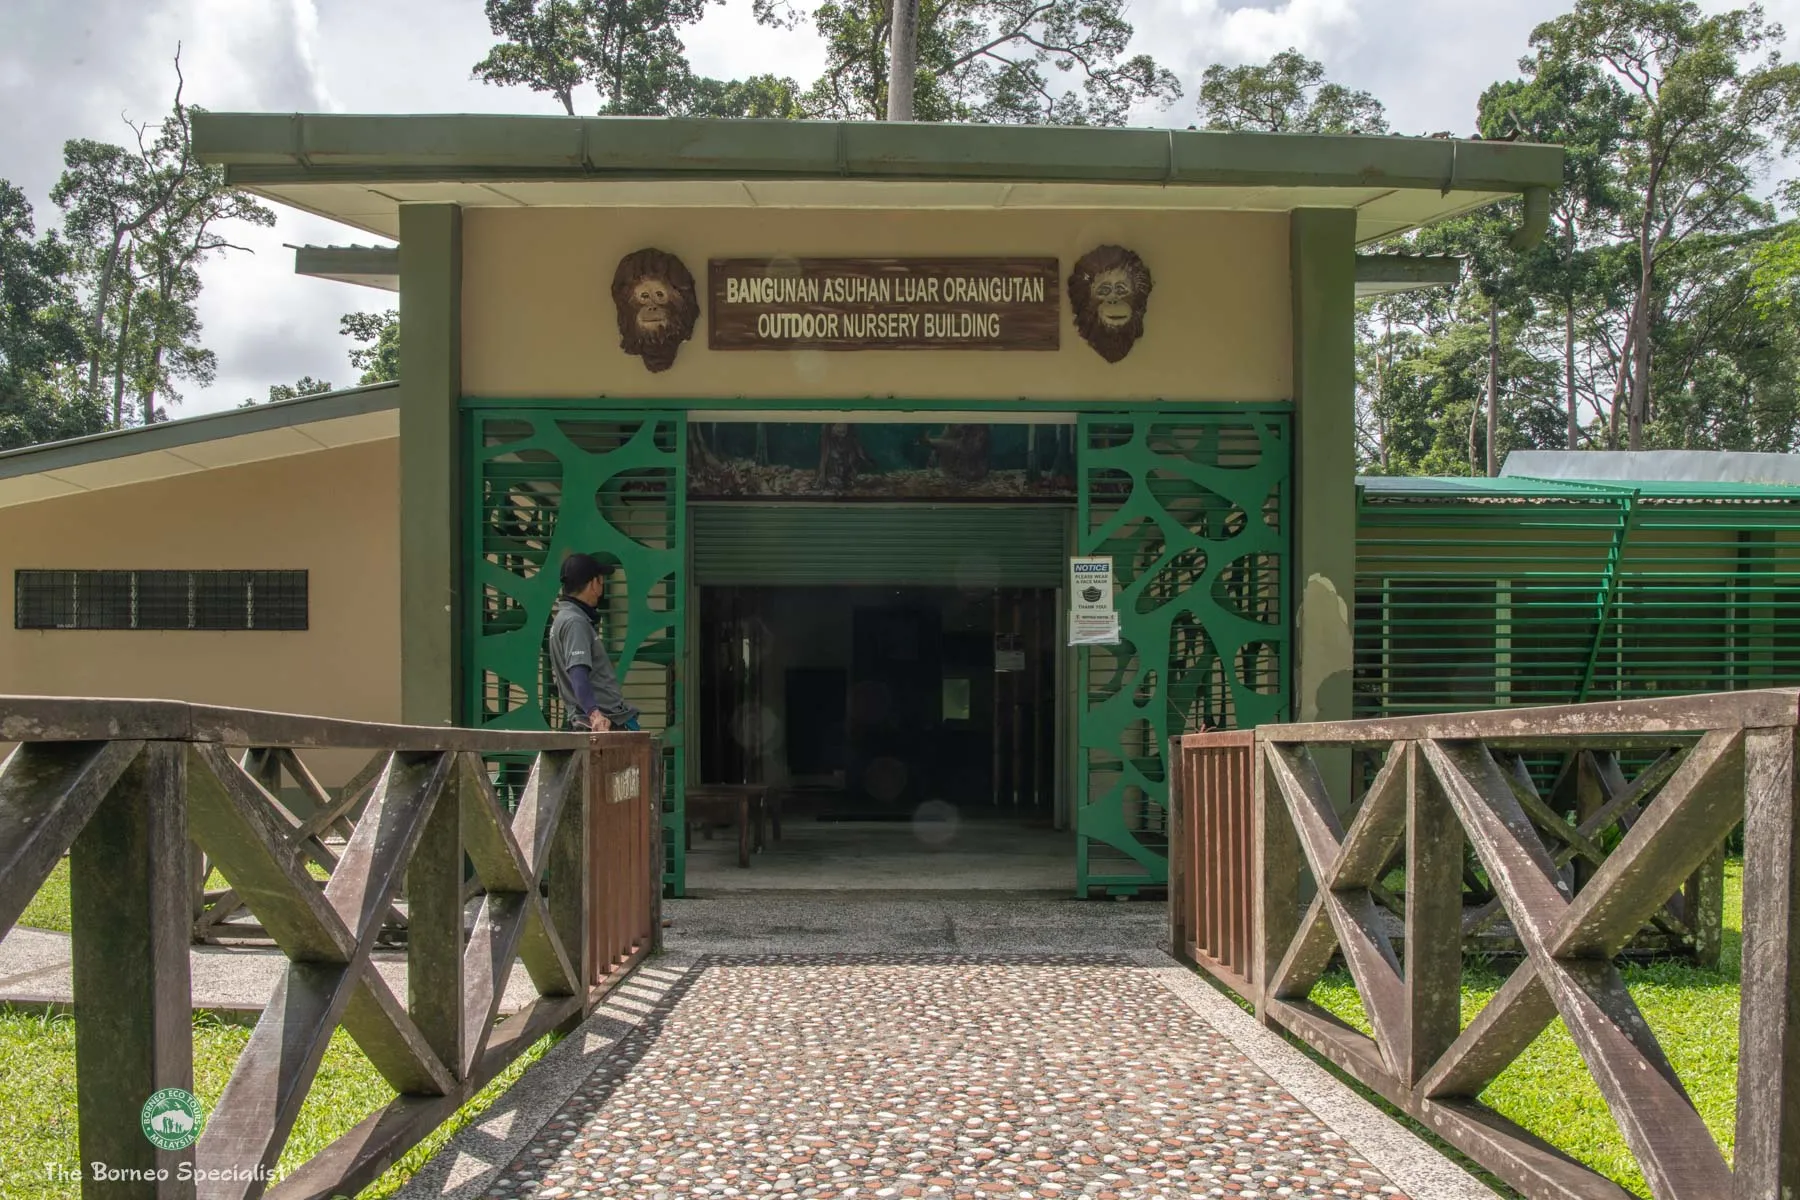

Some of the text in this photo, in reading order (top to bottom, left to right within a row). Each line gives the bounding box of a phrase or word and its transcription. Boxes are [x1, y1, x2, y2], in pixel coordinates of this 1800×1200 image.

[727, 277, 1044, 303] BANGUNAN ASUHAN LUAR ORANGUTAN
[758, 313, 1000, 338] OUTDOOR NURSERY BUILDING
[1075, 564, 1108, 572] NOTICE
